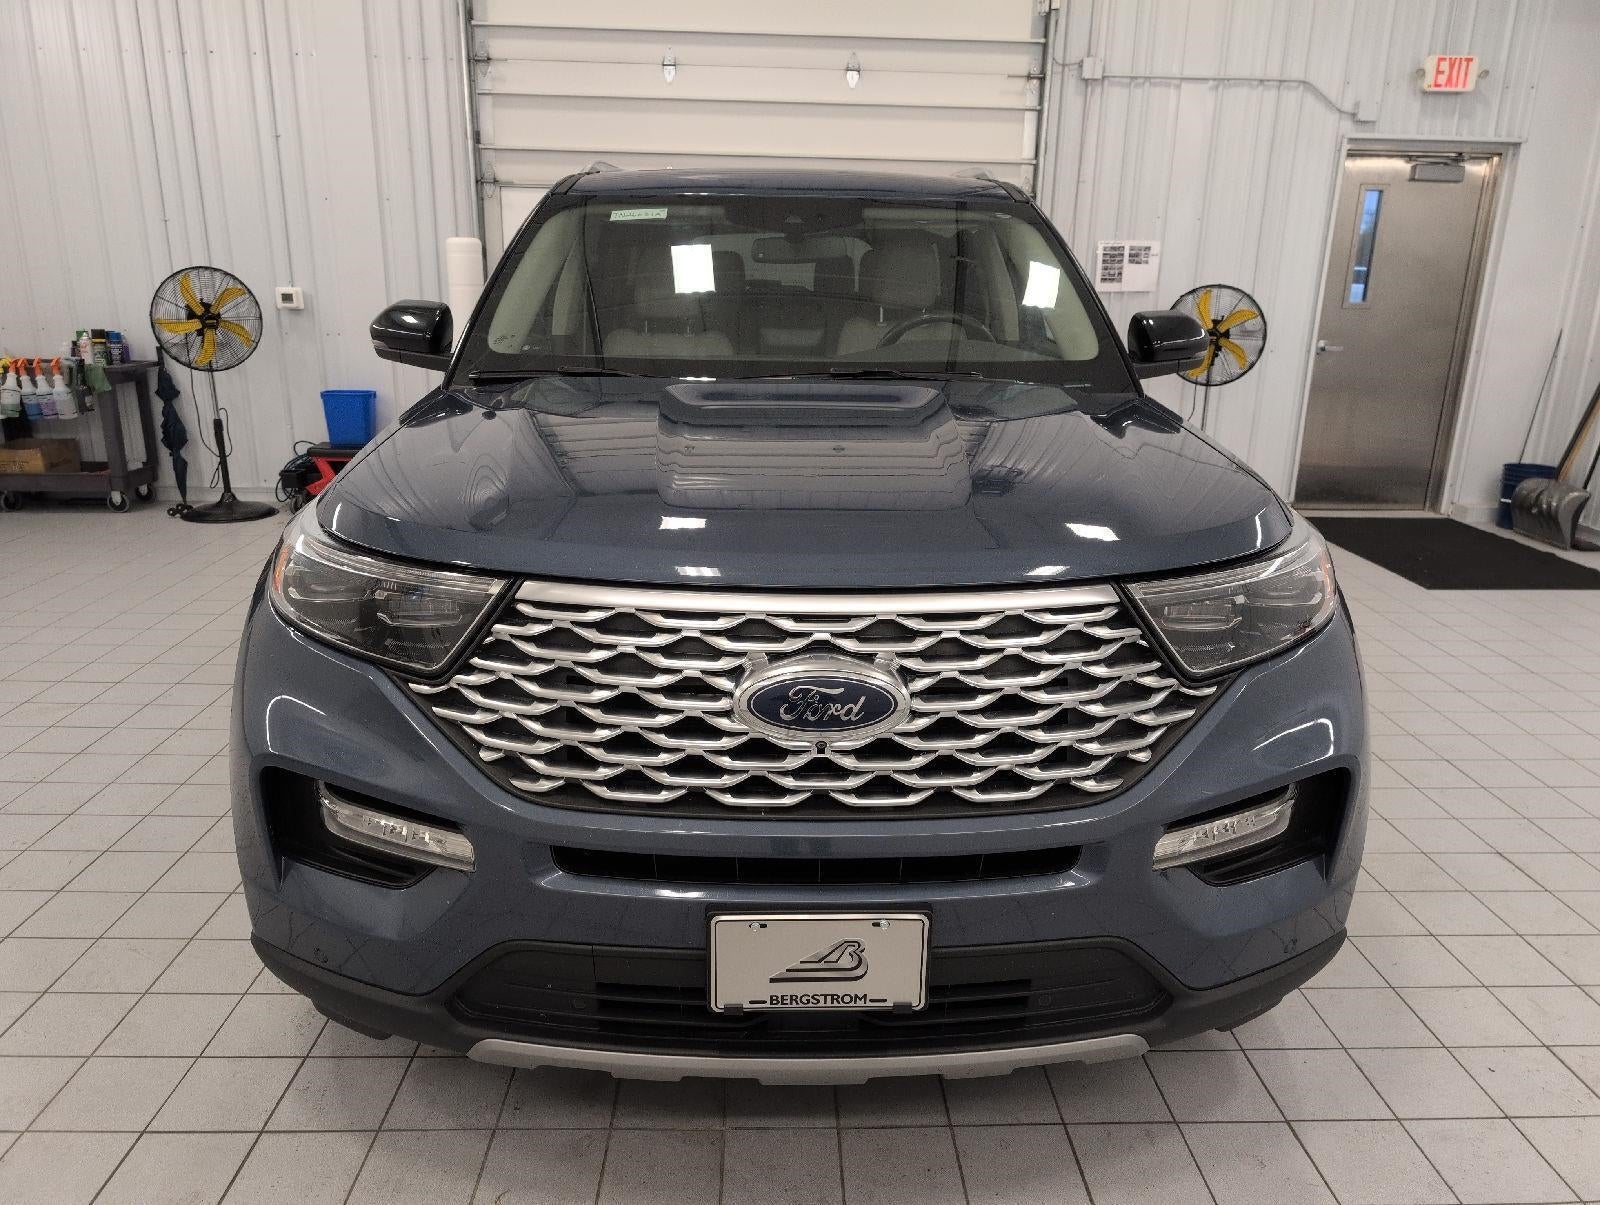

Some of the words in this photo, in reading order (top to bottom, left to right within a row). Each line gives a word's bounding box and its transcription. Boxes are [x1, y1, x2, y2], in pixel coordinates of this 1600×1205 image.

[1433, 57, 1473, 88] EXIT
[779, 685, 866, 721] Ford
[769, 993, 868, 1006] BERGSTROM
